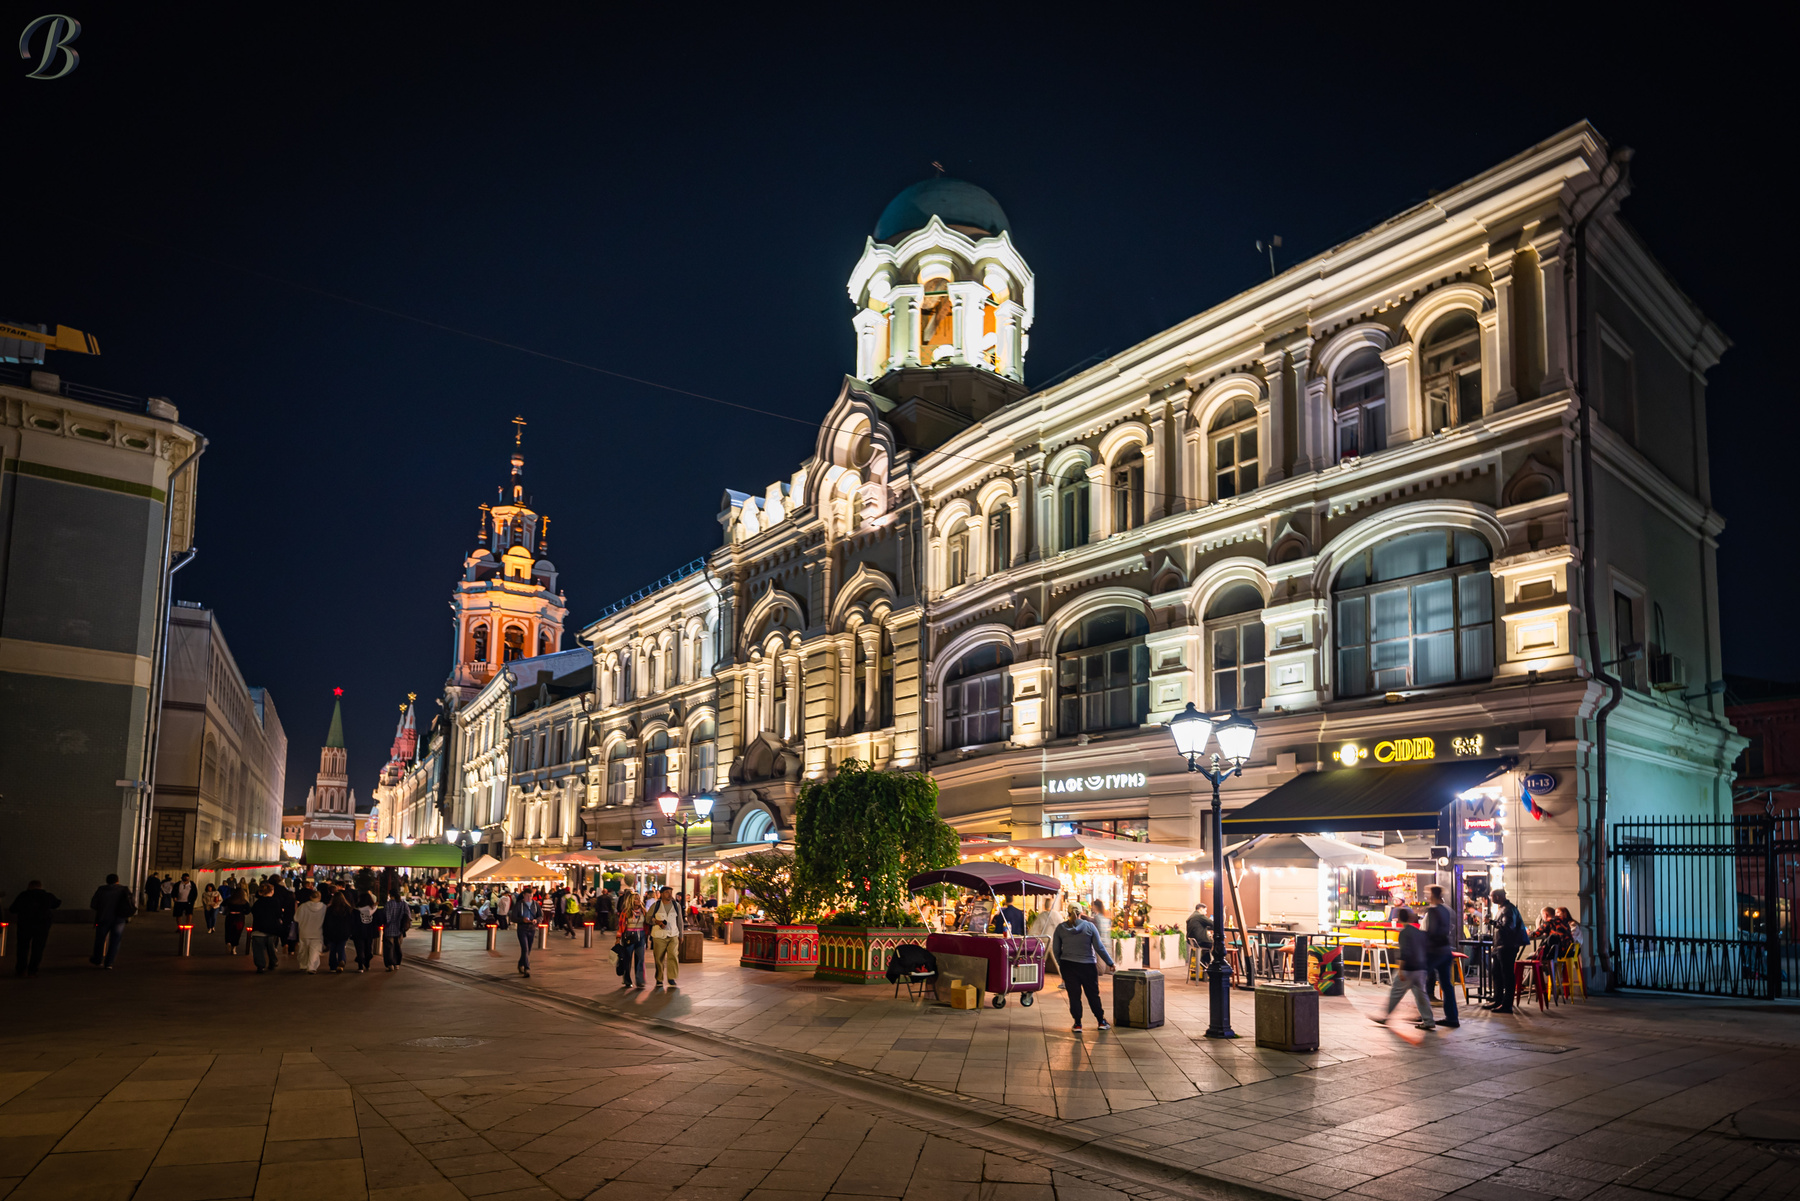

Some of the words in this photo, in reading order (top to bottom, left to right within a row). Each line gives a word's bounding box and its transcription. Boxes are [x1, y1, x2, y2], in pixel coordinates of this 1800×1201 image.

[1374, 737, 1435, 763] CIDER
[1048, 778, 1083, 793] КАФЕ
[1105, 773, 1146, 789] ГУРМЭ
[1527, 778, 1550, 788] 11-13
